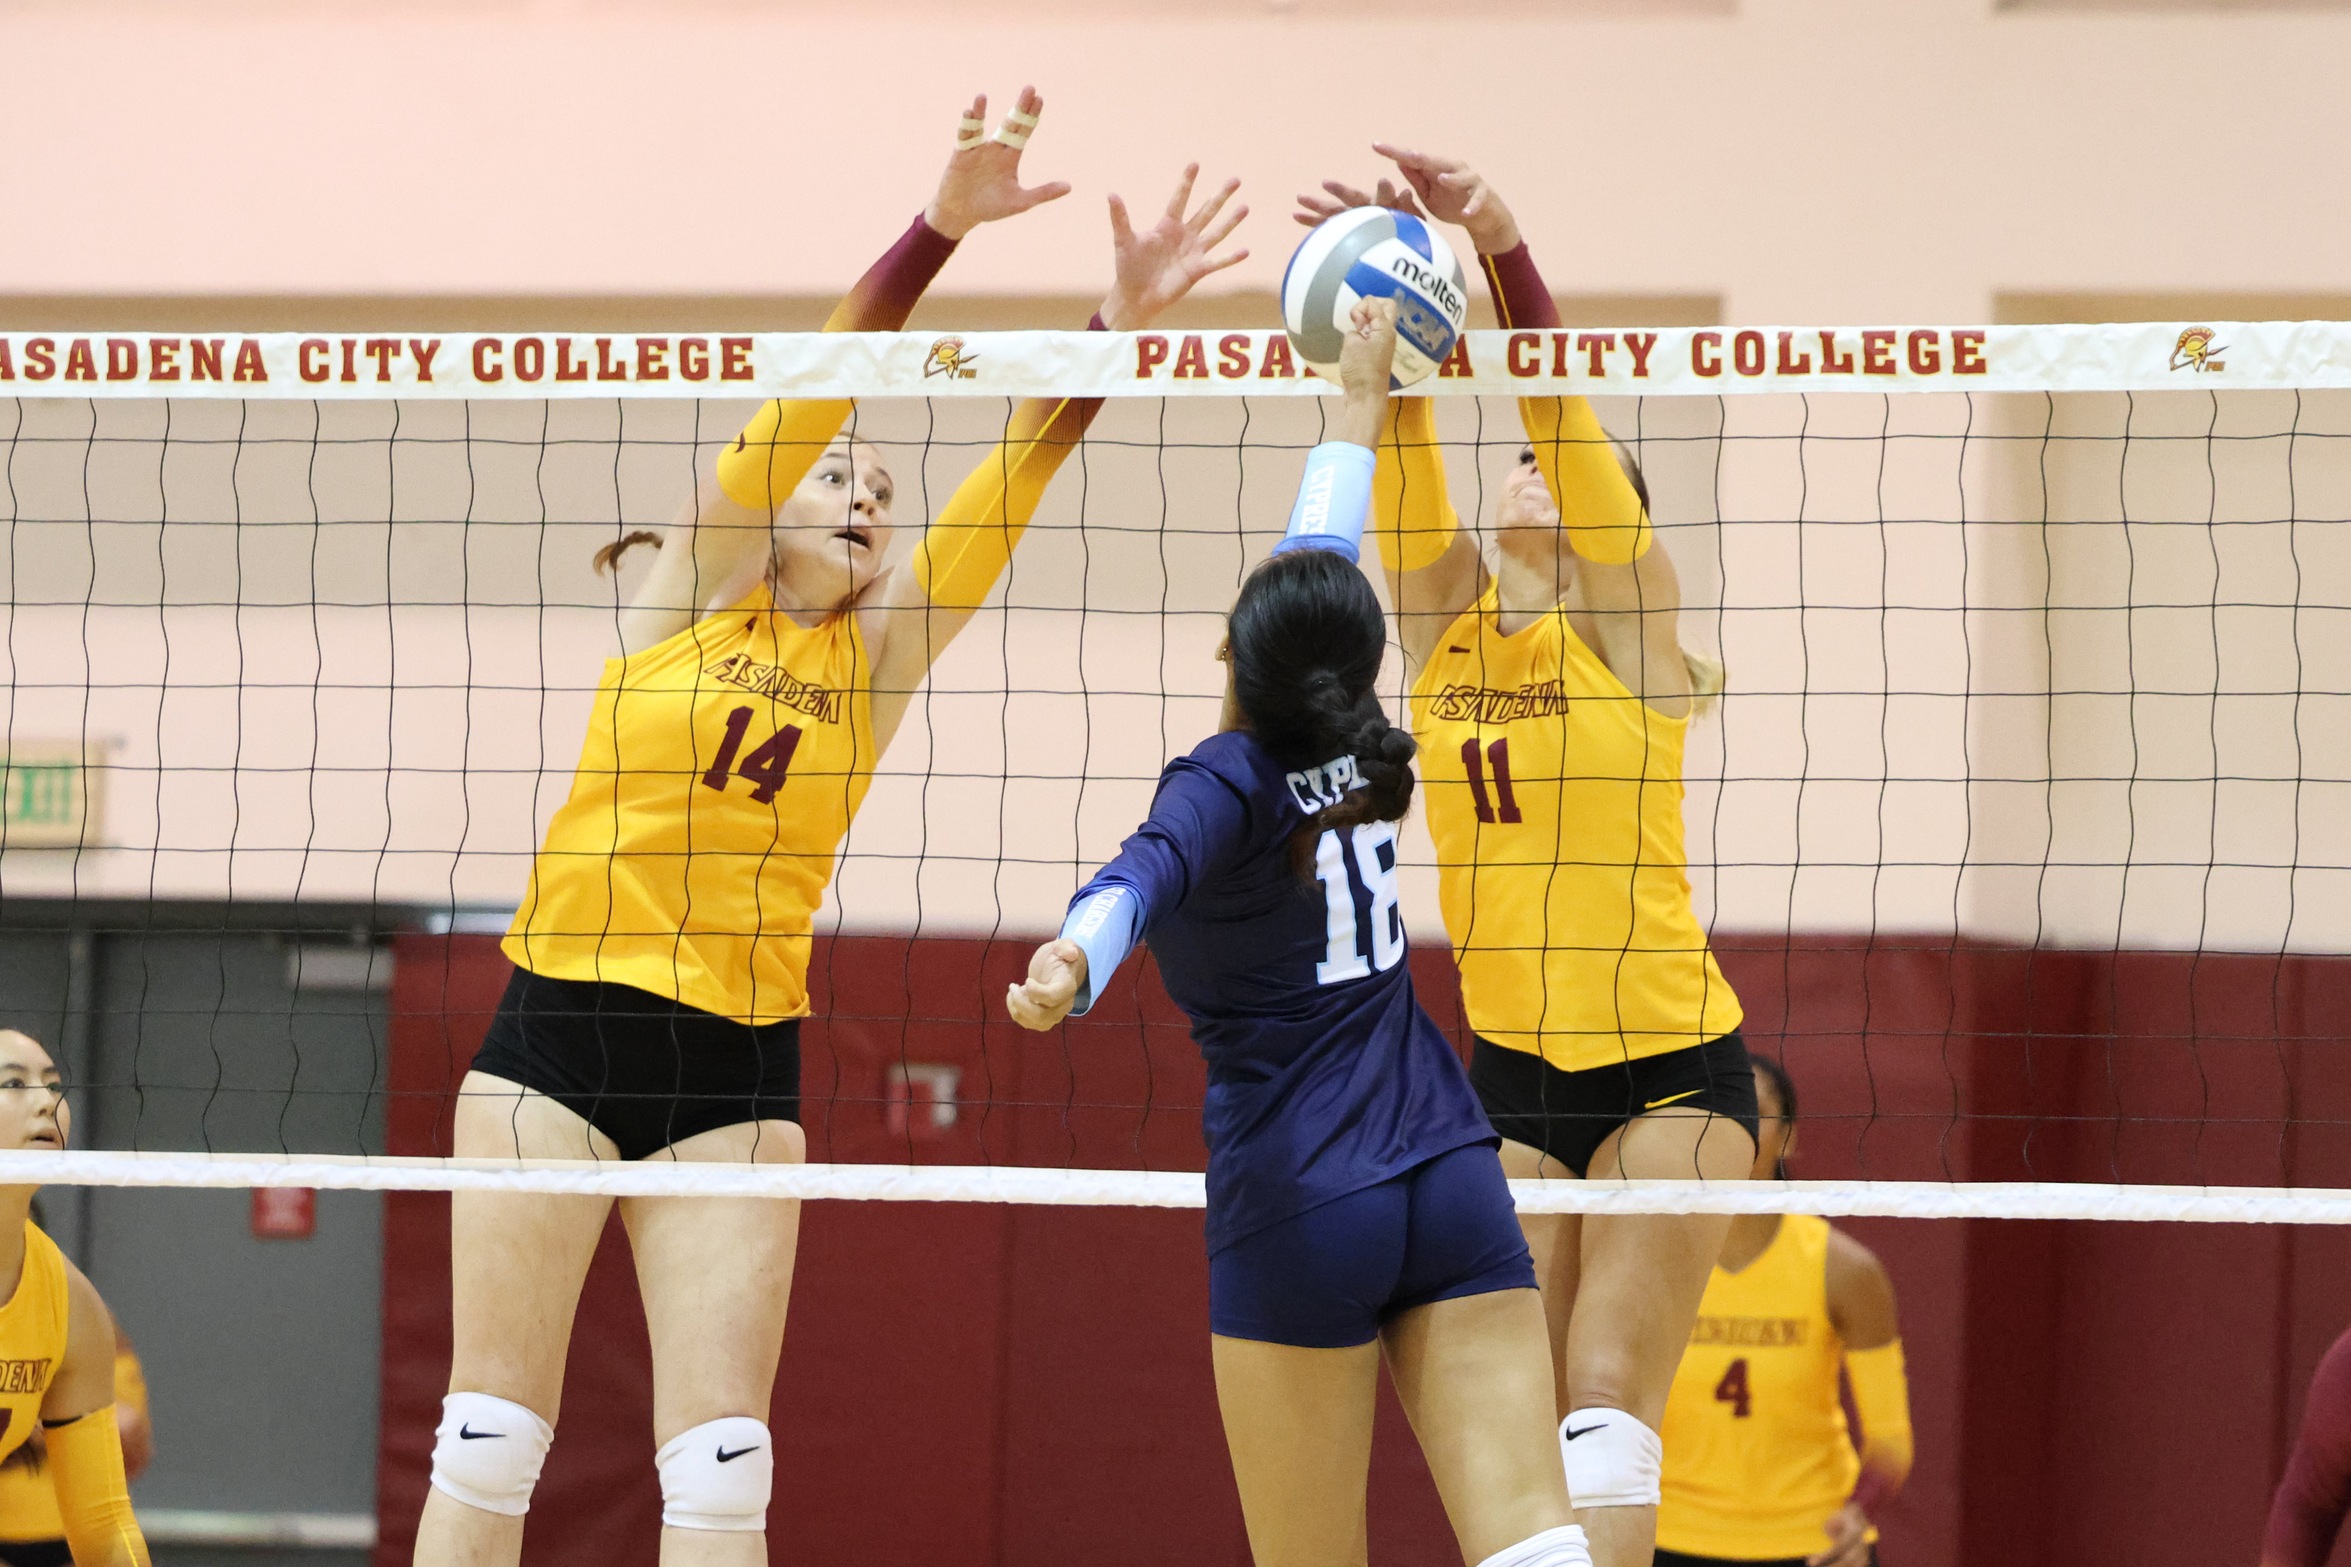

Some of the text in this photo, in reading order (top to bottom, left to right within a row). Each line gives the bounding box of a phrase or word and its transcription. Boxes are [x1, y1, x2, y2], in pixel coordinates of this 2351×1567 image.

[1392, 256, 1464, 326] molten
[299, 339, 440, 382] CITY
[472, 337, 754, 382] COLLEGE
[1136, 334, 1474, 380] PASAA
[1508, 331, 1657, 378] CITY
[1692, 330, 1986, 377] COLLEGE
[702, 705, 803, 806] 14
[1461, 737, 1523, 824] 11
[1316, 819, 1406, 986] 18
[1714, 1357, 1751, 1419] 4
